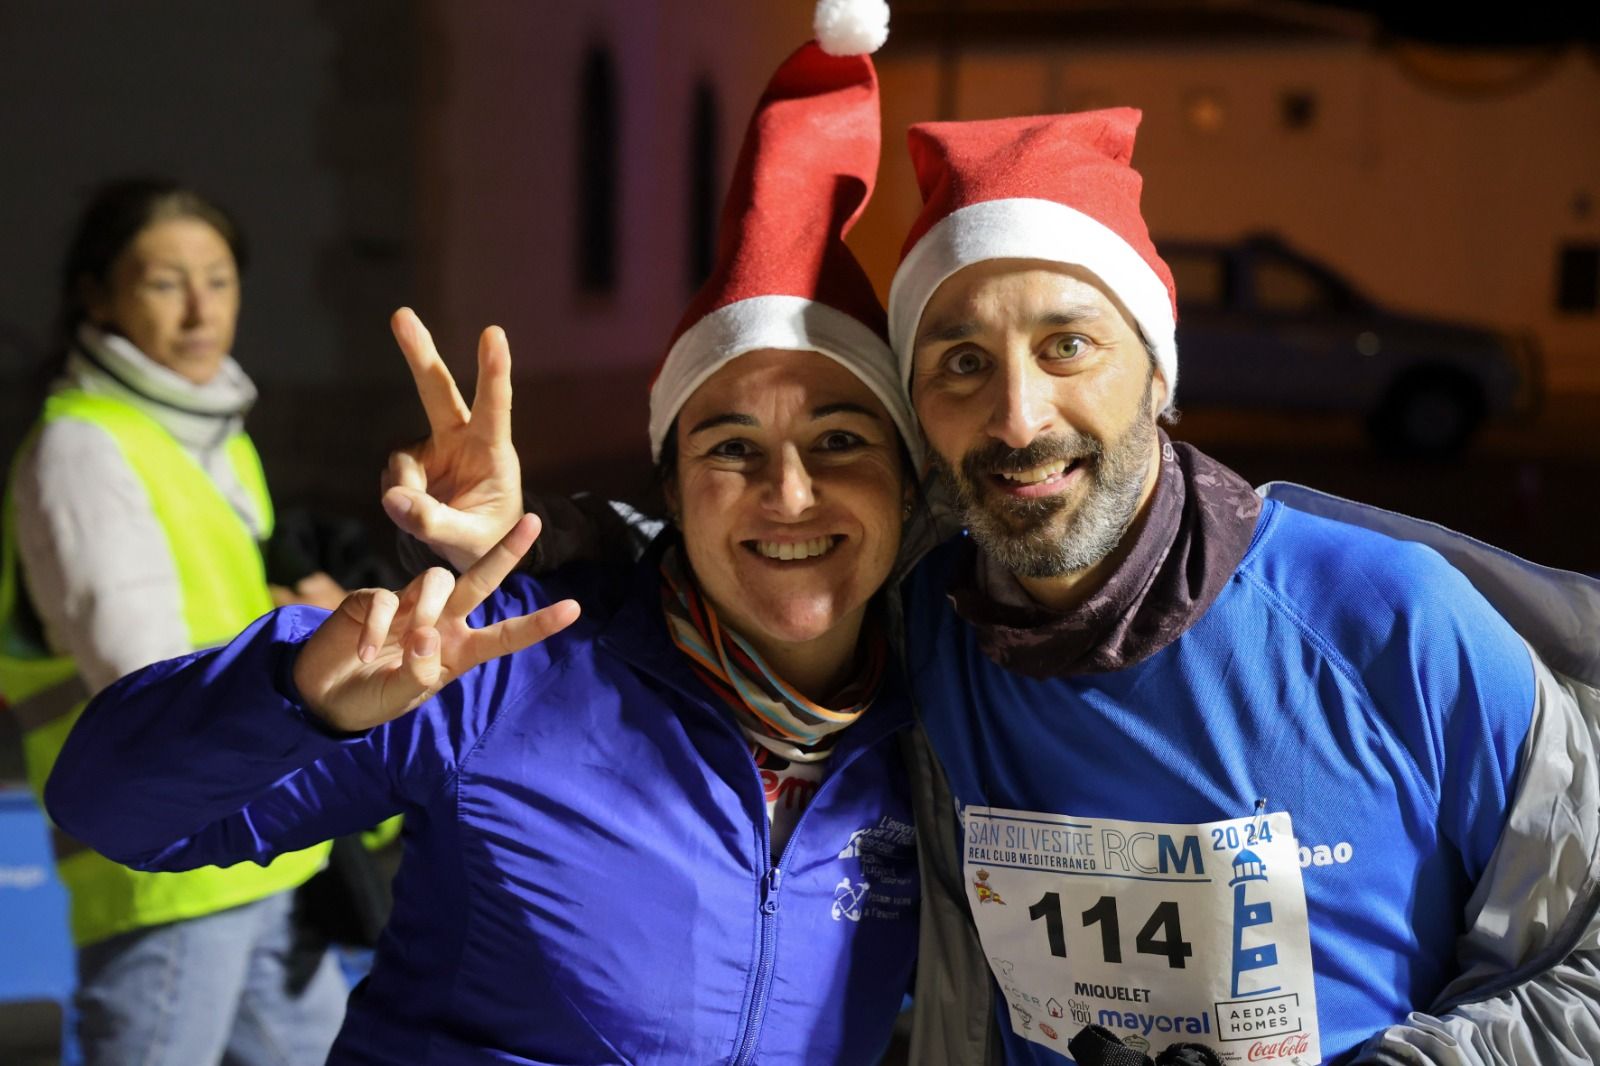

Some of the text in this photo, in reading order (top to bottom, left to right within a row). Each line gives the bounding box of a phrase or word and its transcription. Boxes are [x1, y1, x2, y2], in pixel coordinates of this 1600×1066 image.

[968, 821, 1096, 857] SAN SILVESTRE
[1211, 820, 1273, 851] 2024
[968, 847, 1096, 870] REAL CLUB MEDITERRÁNEO
[1100, 828, 1205, 875] RCM
[1028, 891, 1193, 969] 114
[1074, 982, 1151, 1003] MIQUELET
[1067, 998, 1090, 1012] Only
[1070, 1008, 1091, 1025] YOU
[1230, 1003, 1287, 1020] AEDAS
[1098, 1009, 1211, 1036] mayoral
[1231, 1016, 1288, 1033] HOMES
